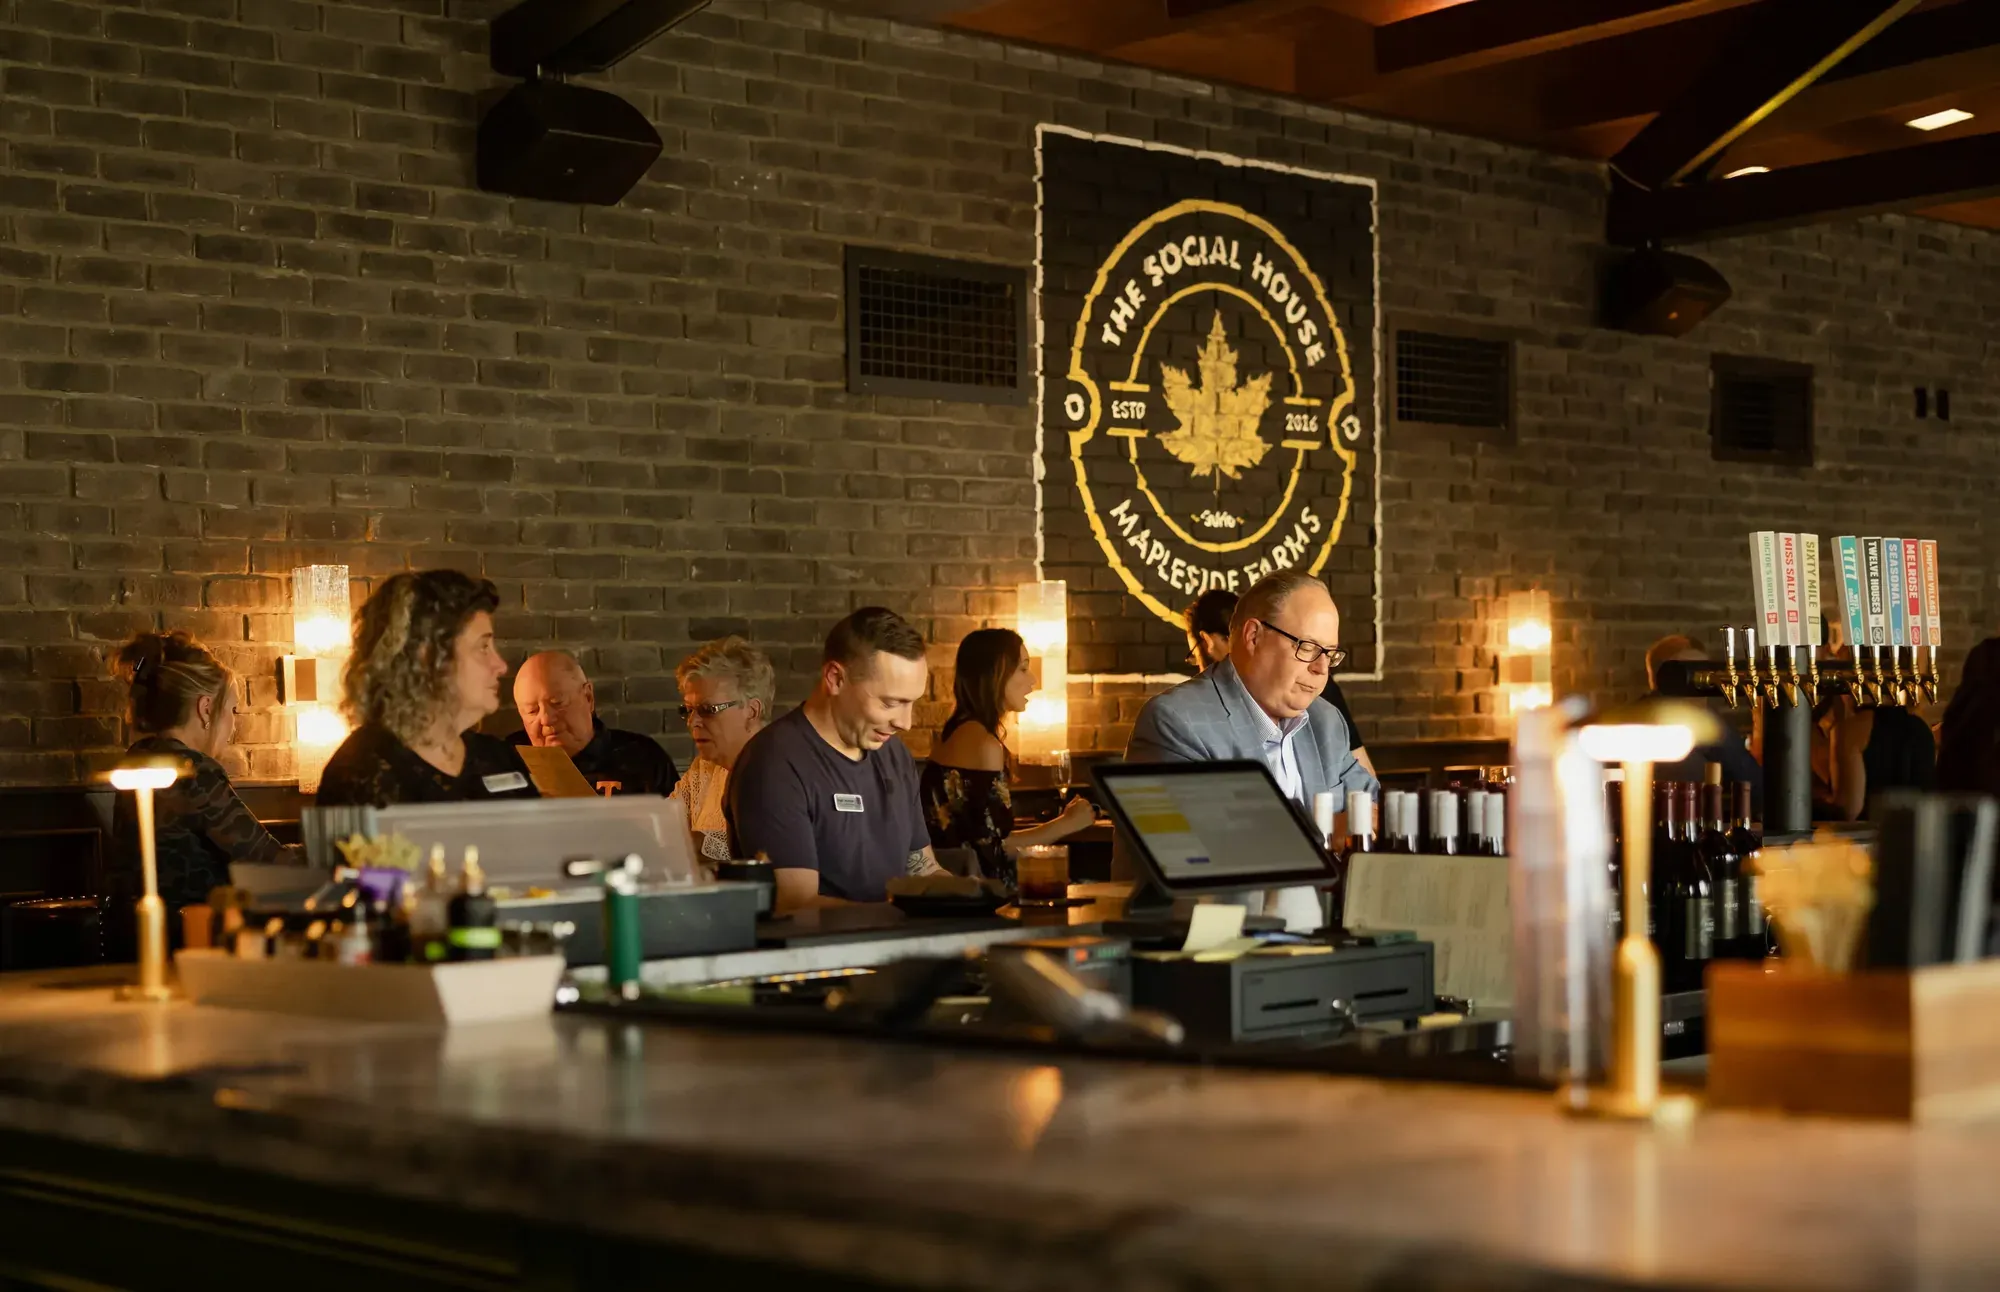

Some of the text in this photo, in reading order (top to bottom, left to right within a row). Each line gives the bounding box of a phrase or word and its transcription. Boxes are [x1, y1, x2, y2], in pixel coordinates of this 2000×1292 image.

[1101, 235, 1327, 367] THE SOCIAL HOUSE
[1111, 400, 1147, 419] ESTD
[1285, 413, 1319, 432] 2016
[1110, 499, 1321, 597] MAPLESIDE FARMS
[1784, 537, 1794, 565] MISS
[1806, 541, 1817, 576] SIXTY
[1843, 547, 1858, 580] 1777
[1868, 541, 1879, 577] TWELVE
[1925, 544, 1934, 582] PUMPKIN
[1786, 568, 1796, 603] SALLY
[1888, 543, 1901, 607] SEASONAL
[1906, 544, 1918, 598] MELROSE
[1808, 579, 1818, 608] MILE
[1870, 578, 1881, 613] HOUSES
[1927, 582, 1937, 614] VILLAGE
[596, 781, 622, 800] T
